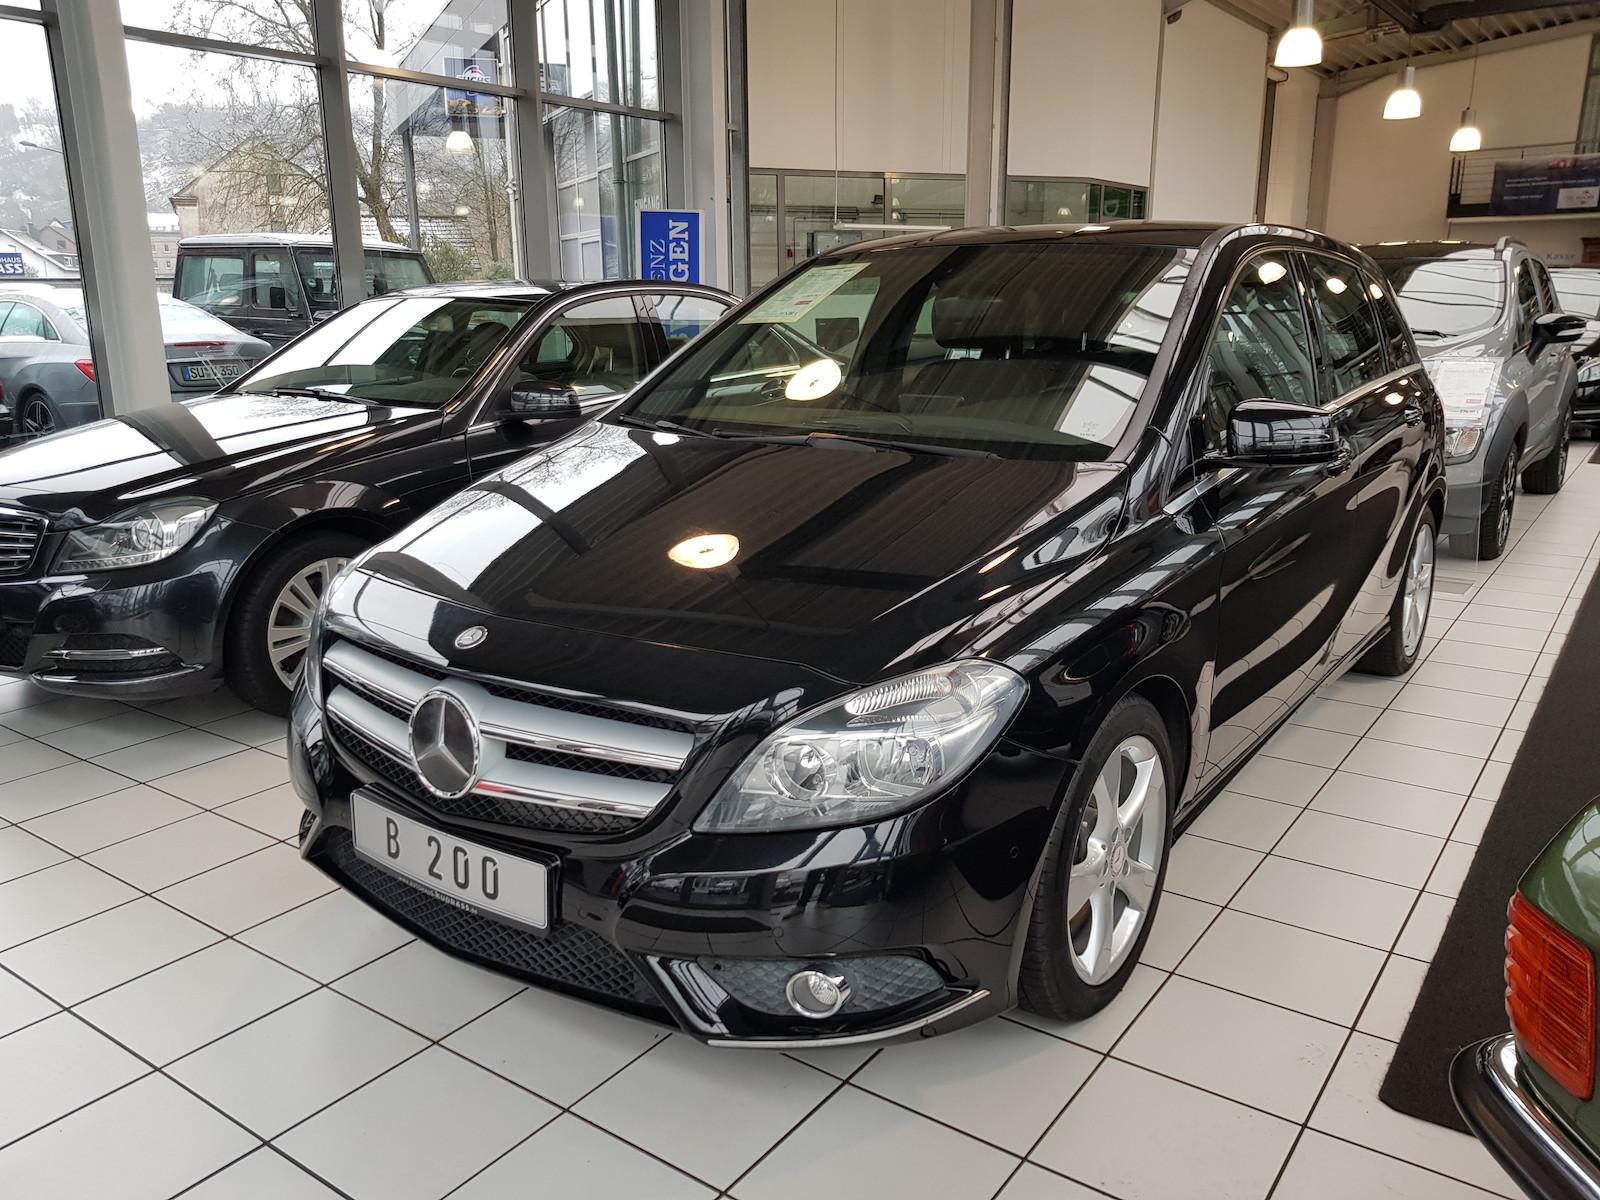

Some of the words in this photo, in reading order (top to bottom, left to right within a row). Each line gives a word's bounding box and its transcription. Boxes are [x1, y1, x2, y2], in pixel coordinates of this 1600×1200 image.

[669, 219, 690, 282] GEN
[190, 367, 205, 378] SU
[386, 817, 400, 860] B
[427, 835, 499, 900] 200
